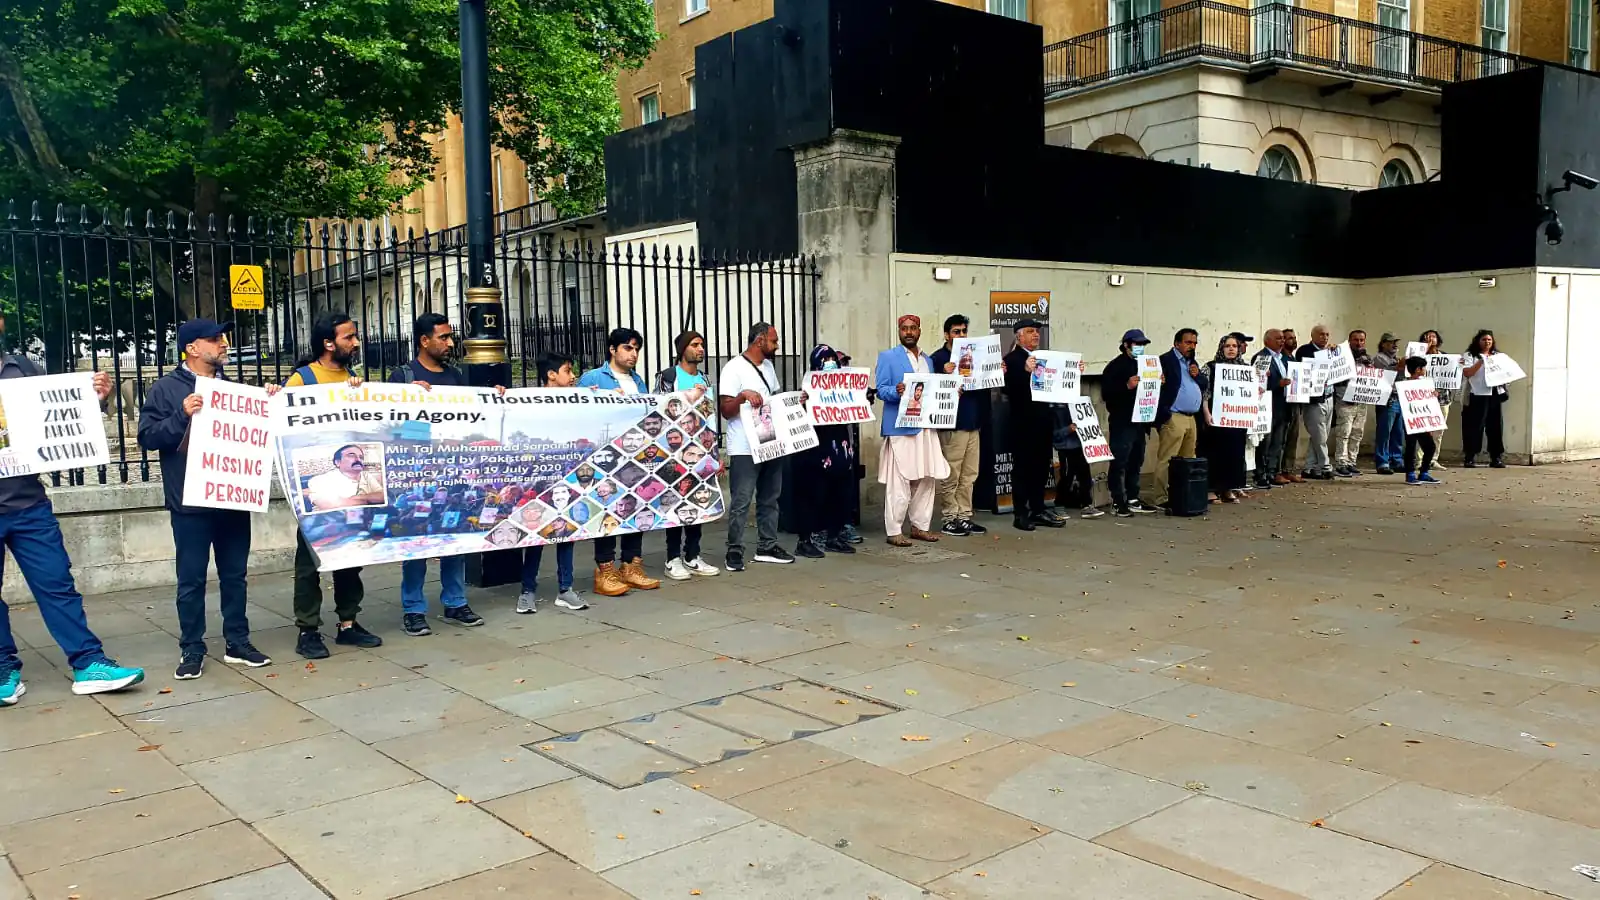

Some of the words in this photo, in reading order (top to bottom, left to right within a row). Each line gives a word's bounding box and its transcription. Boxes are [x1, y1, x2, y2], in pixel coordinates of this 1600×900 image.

[994, 303, 1037, 314] MISSING
[1431, 356, 1449, 366] END
[811, 373, 869, 391] DISAPPEARED
[1222, 368, 1254, 382] RELEASE
[211, 390, 269, 418] RELEASE
[286, 392, 316, 407] In
[328, 387, 474, 405] Balochistan
[478, 392, 589, 405] Thousands
[594, 392, 658, 407] missing
[287, 408, 384, 427] Families
[390, 409, 410, 421] in
[416, 408, 486, 424] Agony.
[812, 405, 871, 423] FORGOTTEN
[1407, 415, 1442, 429] MATTER
[211, 420, 268, 448] BALOCH
[386, 445, 408, 454] Mir
[413, 444, 433, 454] Taj
[437, 443, 520, 453] Muhammad
[522, 442, 577, 452] Sarparah
[202, 452, 262, 476] MISSING
[387, 455, 456, 466] Abducted
[459, 455, 476, 465] by
[480, 454, 536, 464] Pakistan
[539, 452, 584, 462] Security
[387, 468, 438, 480] Agency
[462, 467, 480, 475] on
[484, 466, 498, 474] 19
[503, 464, 529, 475] July
[533, 463, 562, 473] 2020
[997, 474, 1007, 484] ON
[205, 481, 264, 506] PERSONS
[996, 485, 1004, 494] BY
